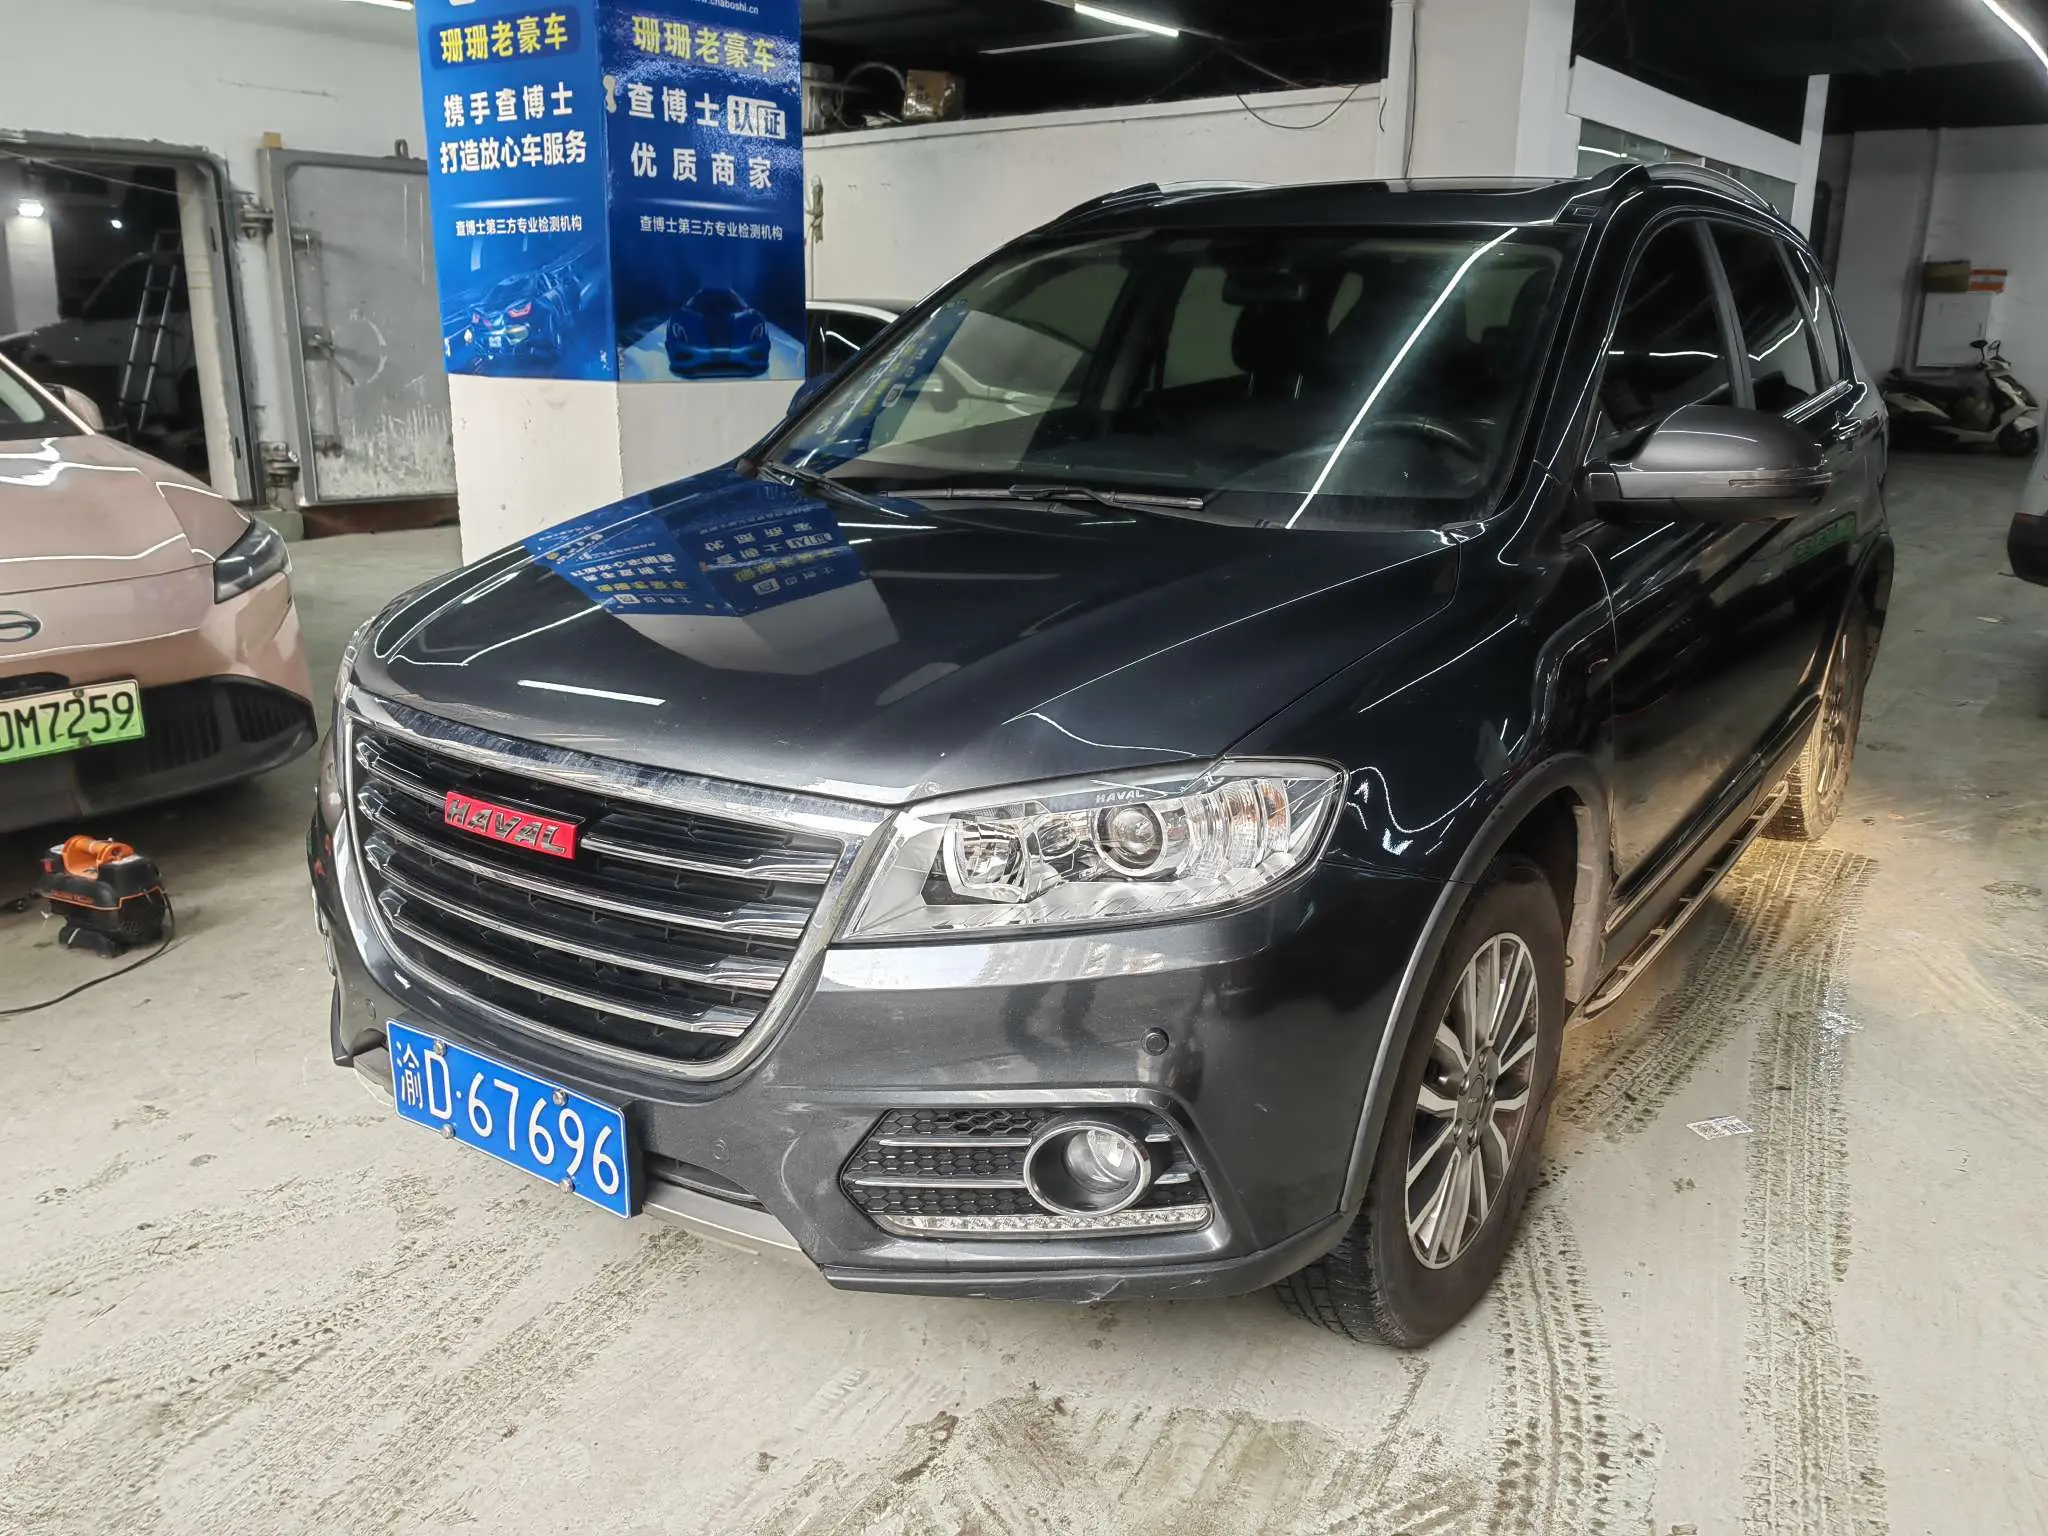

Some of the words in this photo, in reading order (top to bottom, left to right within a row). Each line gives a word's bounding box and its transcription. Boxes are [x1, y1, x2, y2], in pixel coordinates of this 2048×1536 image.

[440, 12, 568, 64] 珊珊老豪车
[632, 15, 776, 73] 珊珊老豪车
[444, 81, 573, 128] 携手查博士
[440, 129, 587, 174] 打造放心车服务
[631, 142, 772, 189] 优质商家
[456, 214, 582, 236] 查博士第三方专业检测机构
[640, 215, 783, 241] 查博士第三方专业检测机构
[1096, 790, 1144, 803] HAVAL
[447, 799, 566, 855] HAVAL
